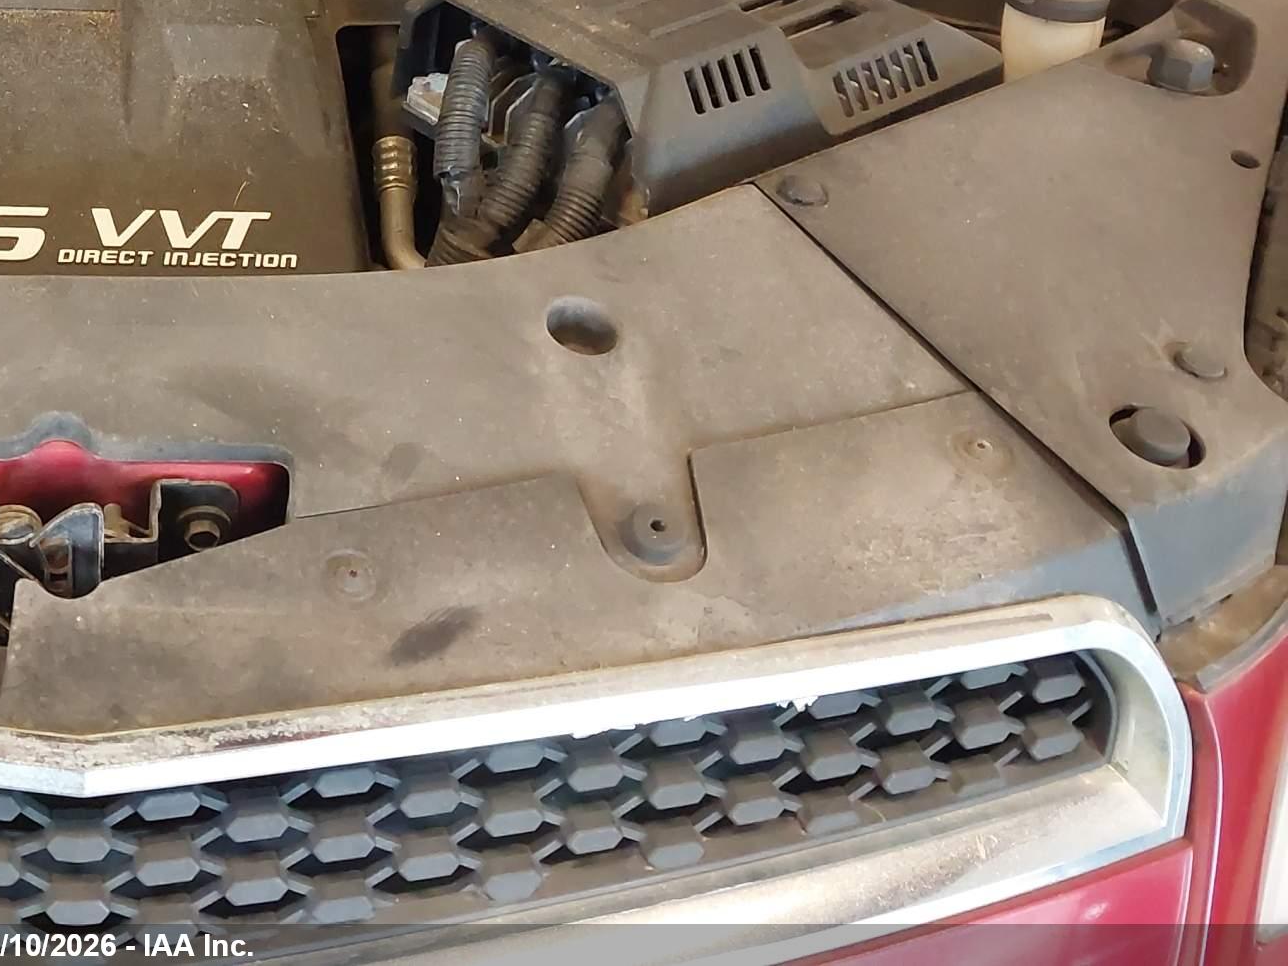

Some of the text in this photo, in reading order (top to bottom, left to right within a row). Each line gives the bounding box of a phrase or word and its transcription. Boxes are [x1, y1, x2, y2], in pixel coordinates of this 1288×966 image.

[90, 207, 272, 251] VVT
[57, 248, 298, 268] DIRECT INJECTION
